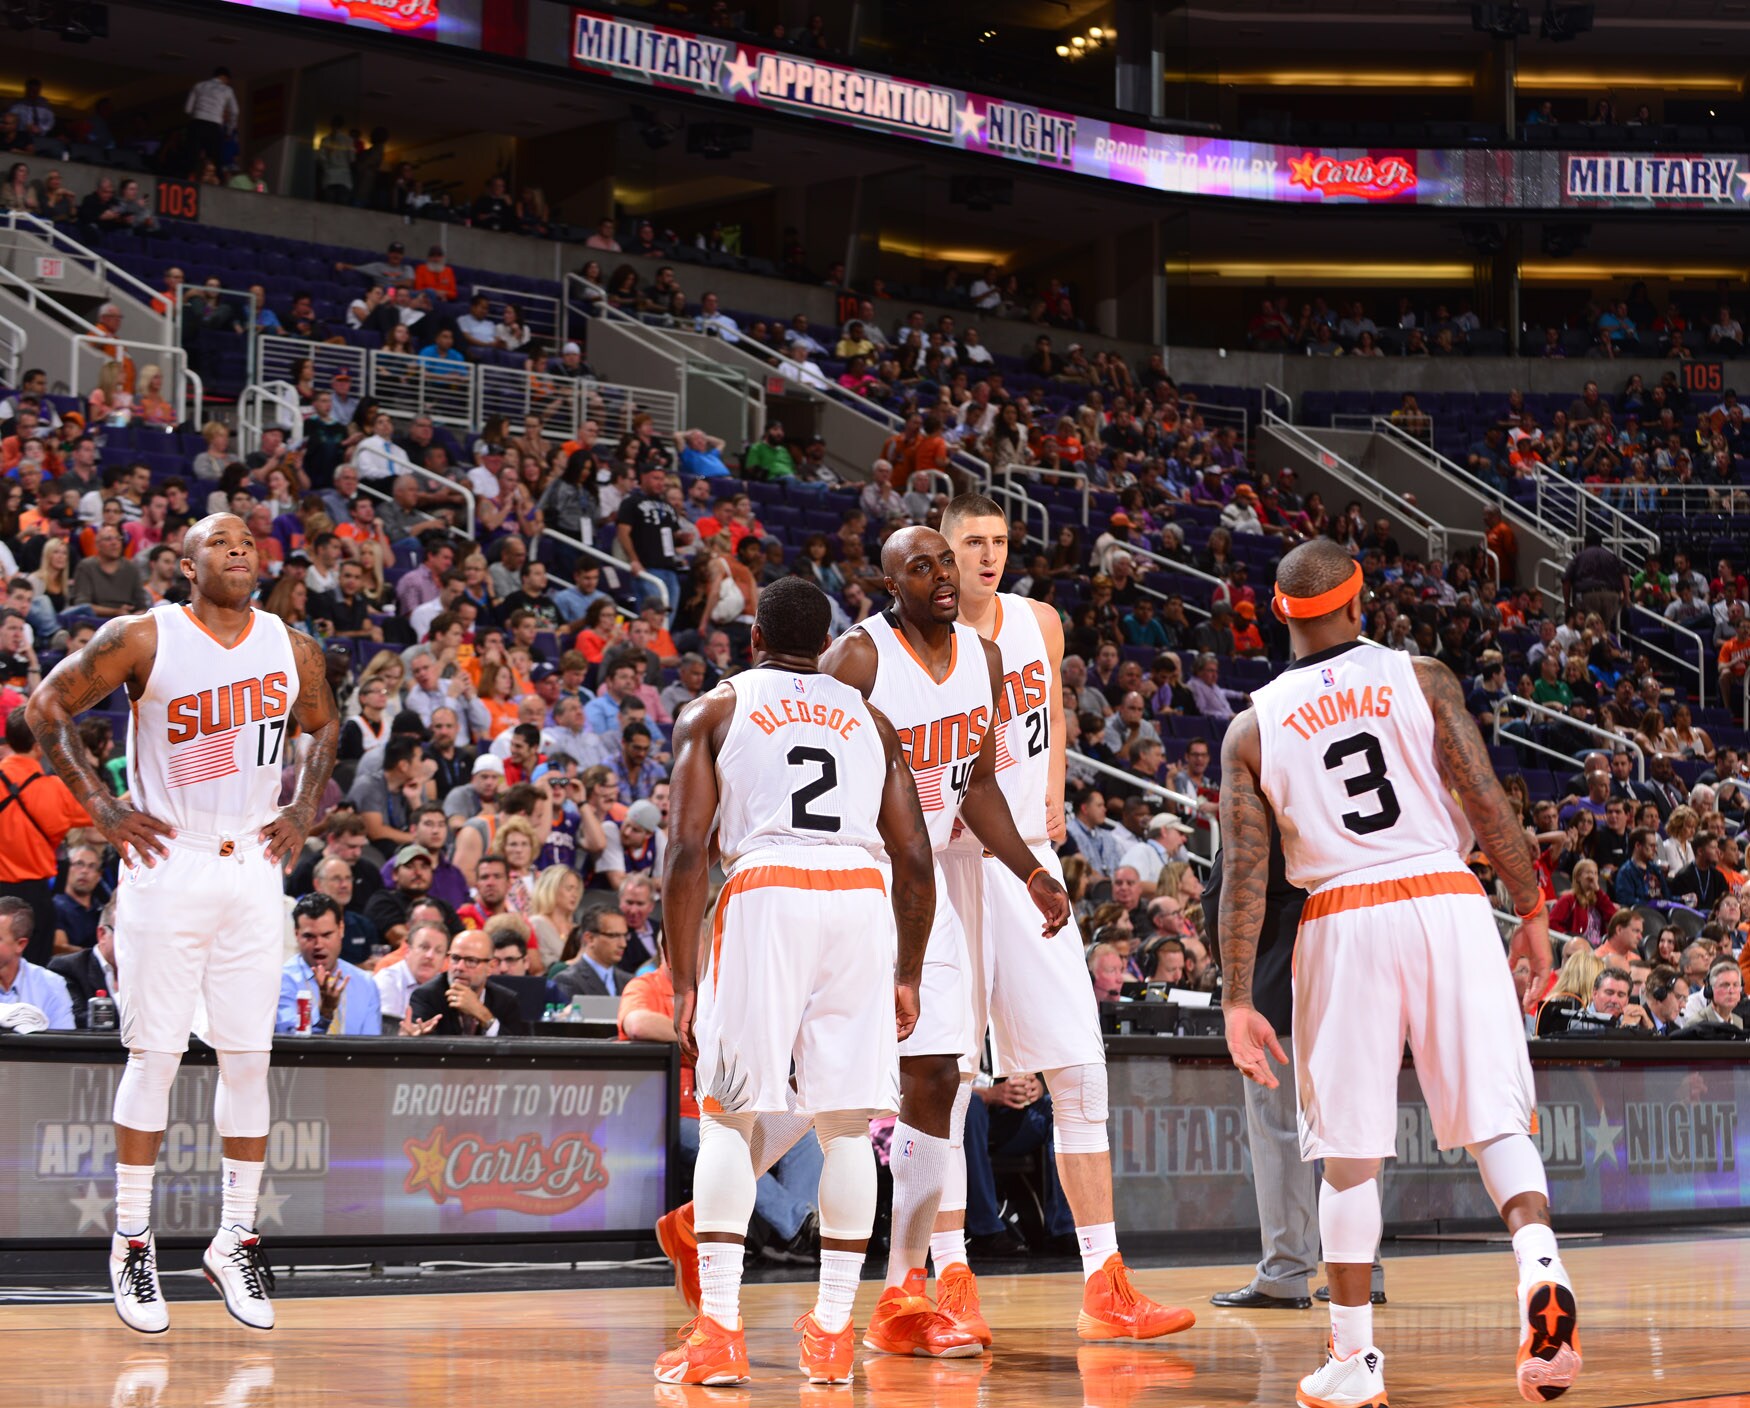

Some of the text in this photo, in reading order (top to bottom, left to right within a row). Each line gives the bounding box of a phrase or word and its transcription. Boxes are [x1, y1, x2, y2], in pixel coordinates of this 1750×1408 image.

[575, 15, 1076, 160] MILITARY APPRECIATION NIGHT
[1093, 136, 1170, 172] BROUGHT
[1568, 157, 1736, 197] MILITARY
[157, 182, 198, 218] 103
[1683, 363, 1722, 392] 105
[167, 670, 288, 745] SUNS
[749, 699, 862, 741] BLEDSOE
[994, 659, 1047, 729] NS
[1282, 685, 1393, 741] THOMAS
[256, 719, 285, 767] 17
[1025, 706, 1050, 758] 21
[786, 745, 842, 833] 2
[1322, 731, 1401, 836] 3
[392, 1083, 631, 1117] BROUGHT TO YOU BY
[40, 1121, 321, 1174] APPCION
[1109, 1107, 1246, 1174] LITAR
[1627, 1103, 1737, 1167] NIGHT
[444, 1139, 604, 1191] Carl's Jr.
[150, 1176, 223, 1231] IGH
